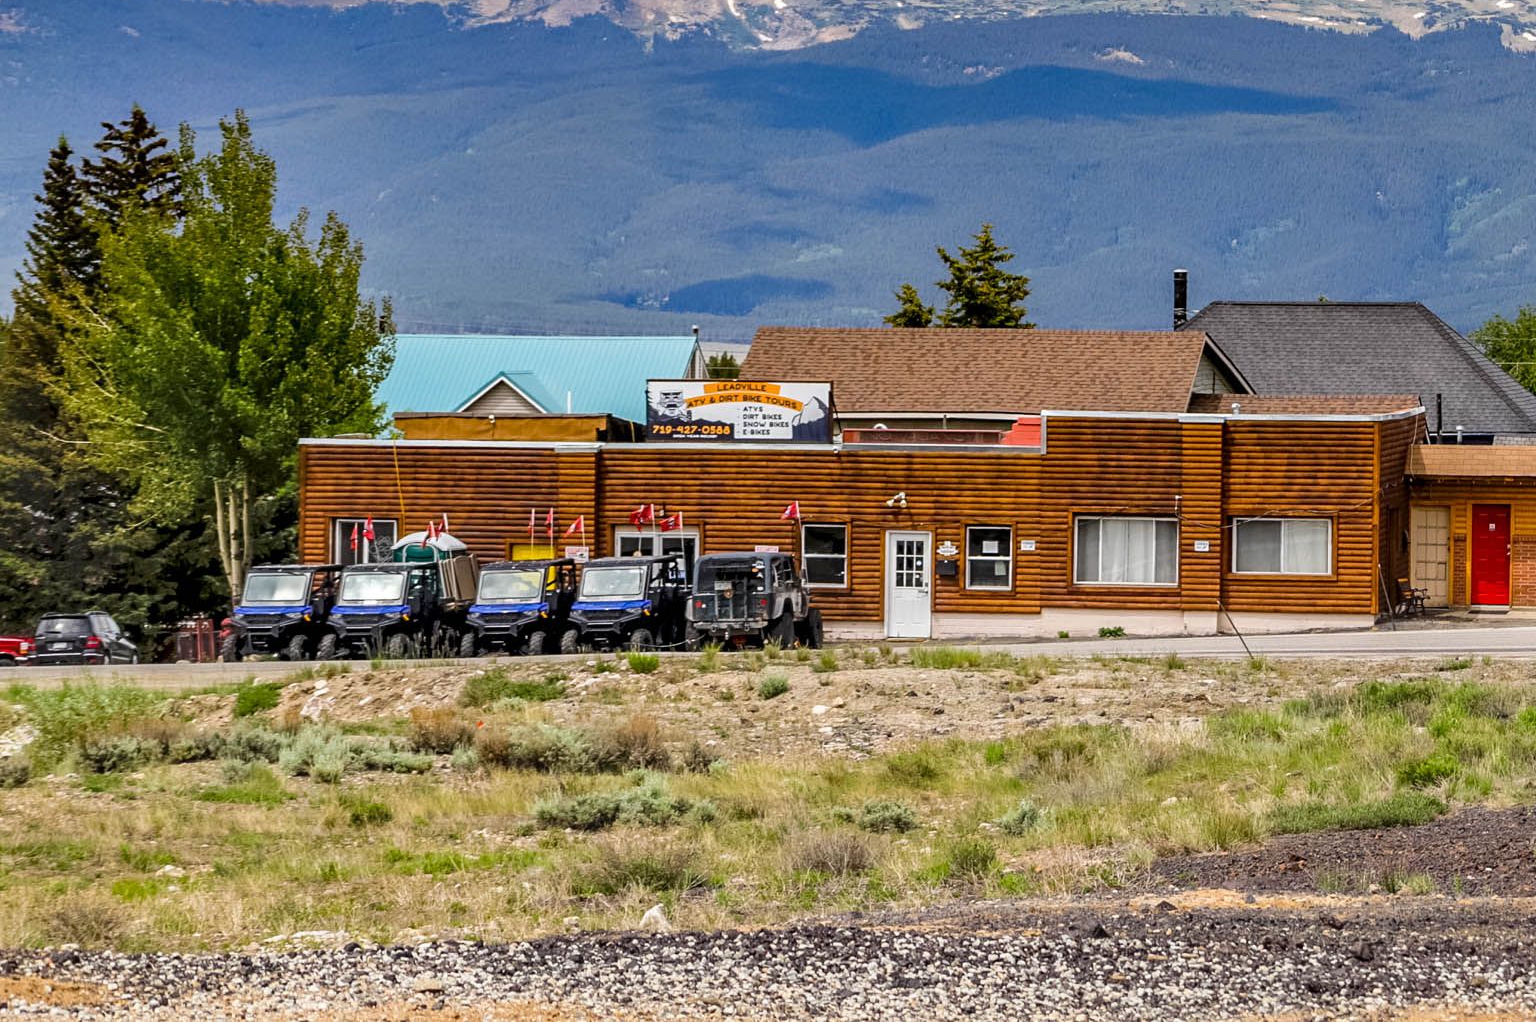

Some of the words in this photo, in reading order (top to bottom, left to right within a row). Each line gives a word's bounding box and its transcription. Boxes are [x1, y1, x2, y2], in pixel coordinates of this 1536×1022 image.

[717, 384, 767, 392] LEADVILLE
[687, 399, 706, 408] ATV
[719, 395, 738, 403] DIRT
[766, 396, 797, 409] TOURS
